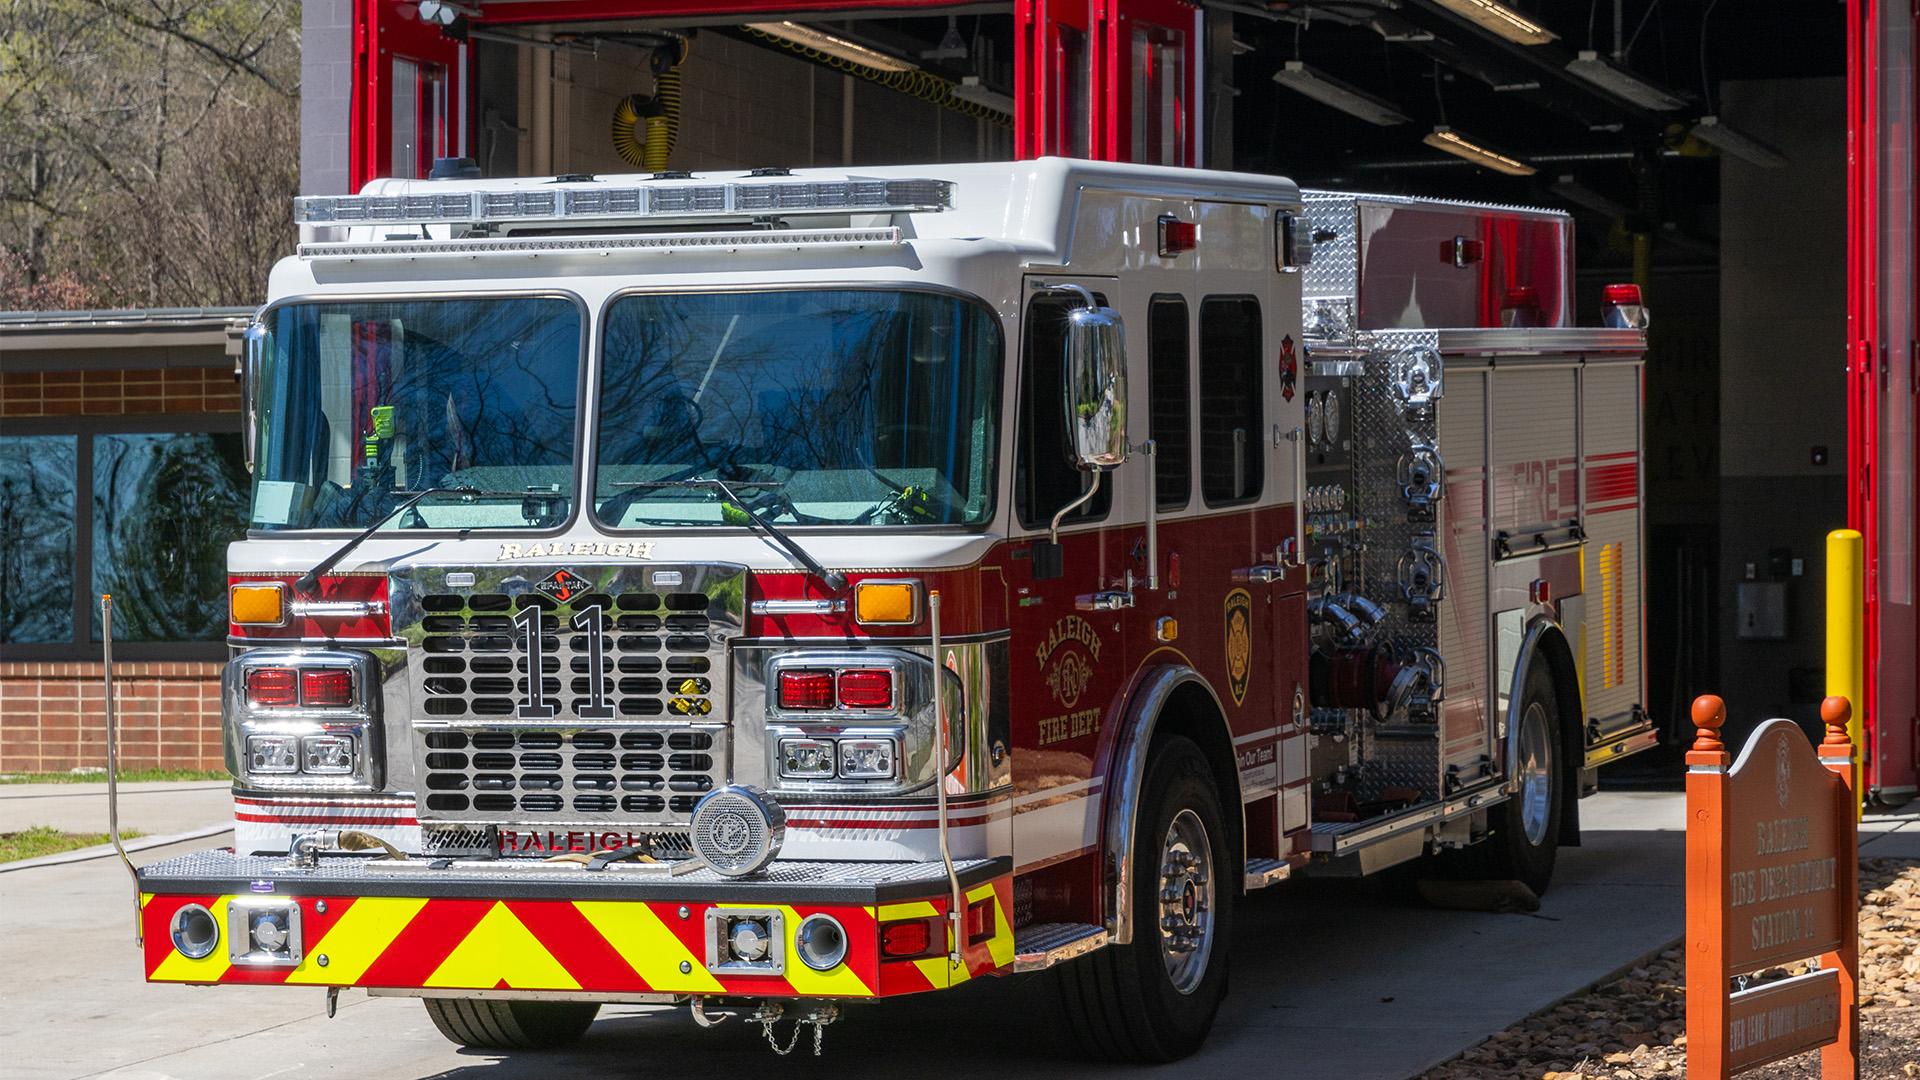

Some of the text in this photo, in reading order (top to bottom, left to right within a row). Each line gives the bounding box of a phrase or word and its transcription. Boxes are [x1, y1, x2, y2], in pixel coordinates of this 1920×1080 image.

[1514, 458, 1558, 527] FIRE
[497, 542, 656, 561] RALEIGH
[540, 580, 584, 590] SPARTAN
[513, 604, 616, 720] 11
[1035, 615, 1103, 674] RALEIGH
[1038, 715, 1068, 746] FIRE
[1245, 751, 1256, 766] Our
[1256, 744, 1273, 763] Team!
[1757, 816, 1808, 856] RALEIGH
[1730, 857, 1836, 907] IRE DEPARTMENT
[1751, 905, 1815, 951] STATION 11
[1730, 1018, 1746, 1053] EVER
